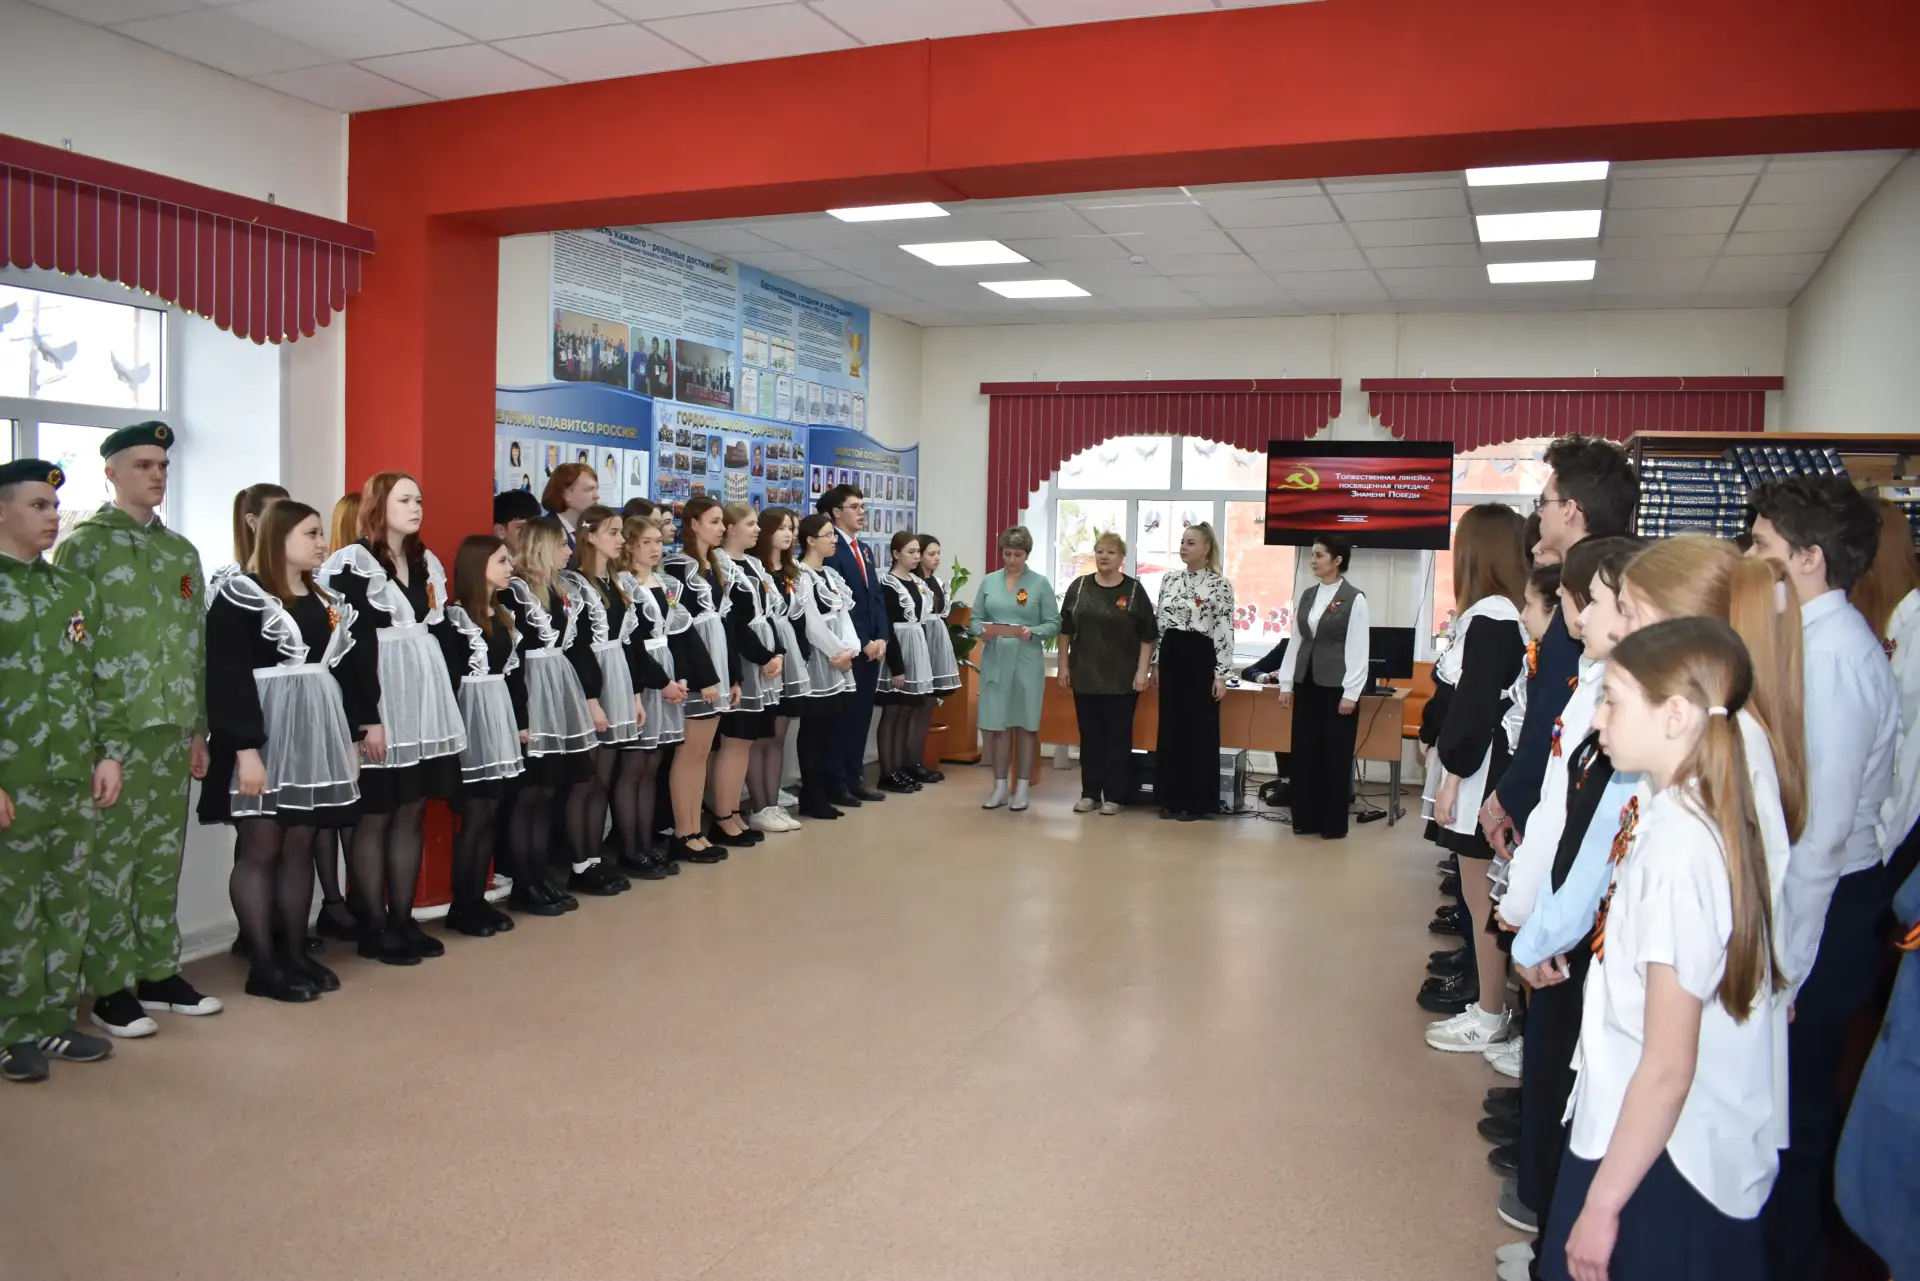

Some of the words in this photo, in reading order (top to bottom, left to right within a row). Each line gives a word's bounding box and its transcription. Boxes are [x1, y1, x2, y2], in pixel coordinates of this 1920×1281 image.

[614, 230, 647, 248] каждого
[652, 243, 685, 261] реальные
[538, 414, 595, 434] СЛАВИТСЯ
[676, 410, 719, 430] ГОРДОСТЬ
